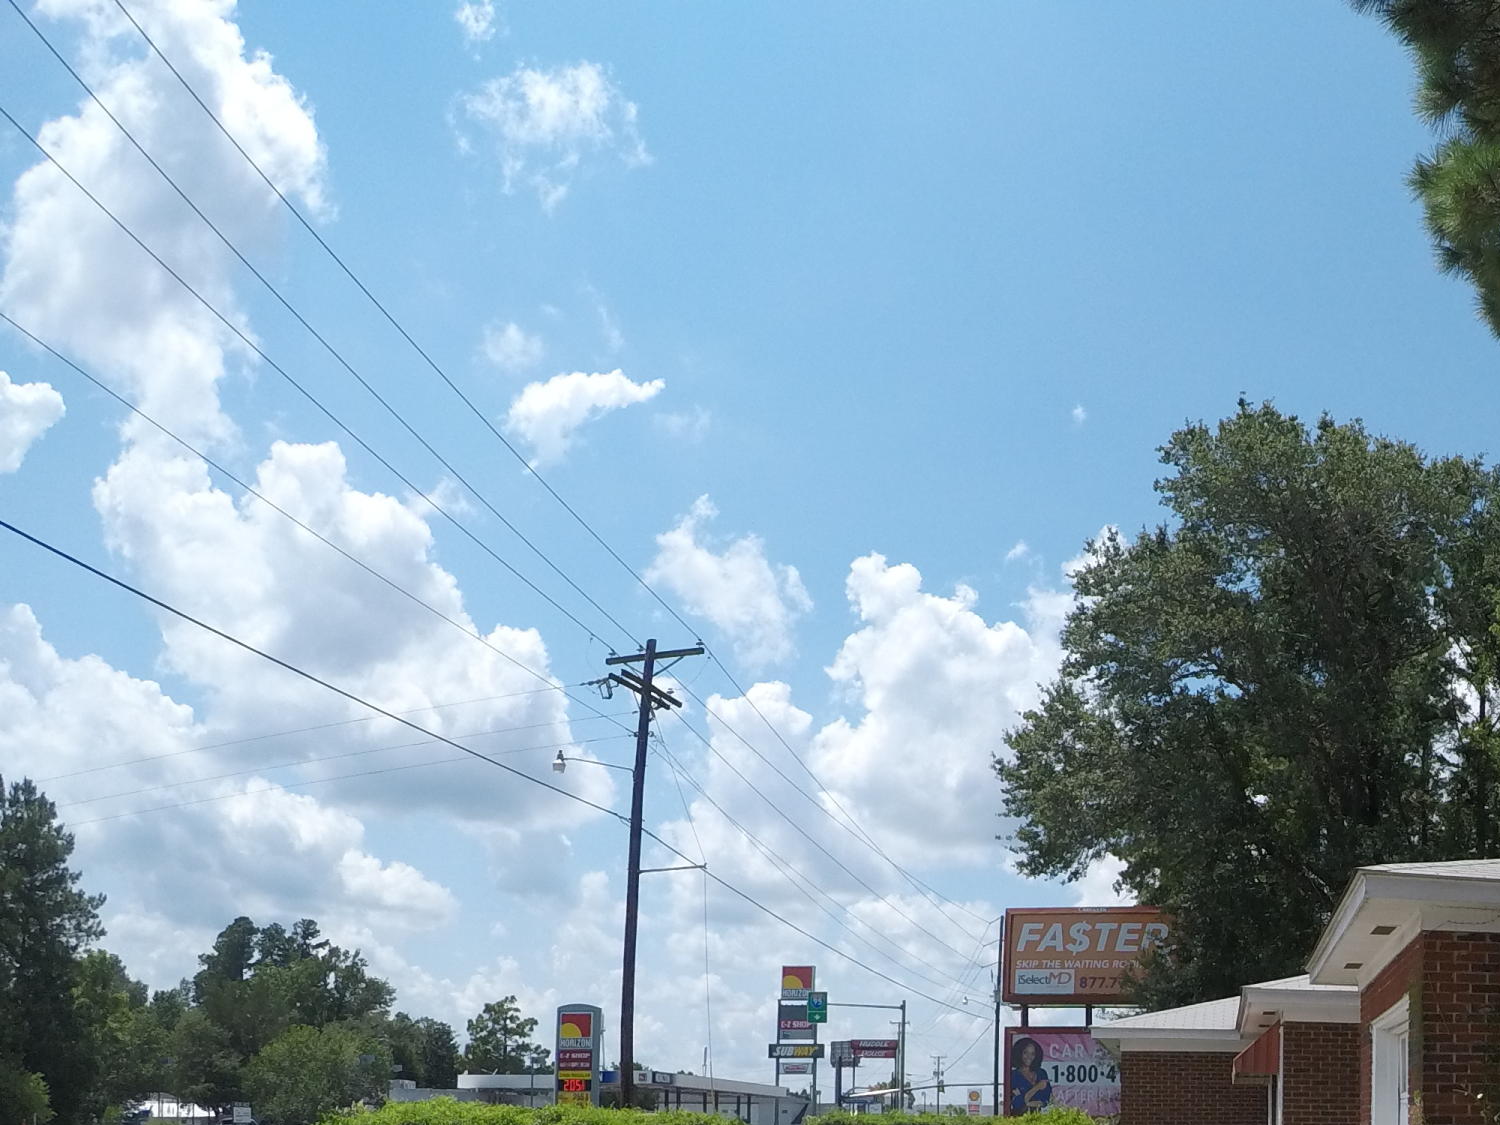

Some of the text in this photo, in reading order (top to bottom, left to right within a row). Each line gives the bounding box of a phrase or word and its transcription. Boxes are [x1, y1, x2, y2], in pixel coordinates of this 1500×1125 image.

[1016, 959, 1039, 969] SKIP
[1042, 959, 1062, 969] THE
[1064, 959, 1110, 969] WAITING
[782, 989, 809, 998] HORIZO
[560, 1038, 591, 1047] HORIZON
[773, 1046, 818, 1056] SUBWAY
[1049, 1043, 1085, 1058] CAR
